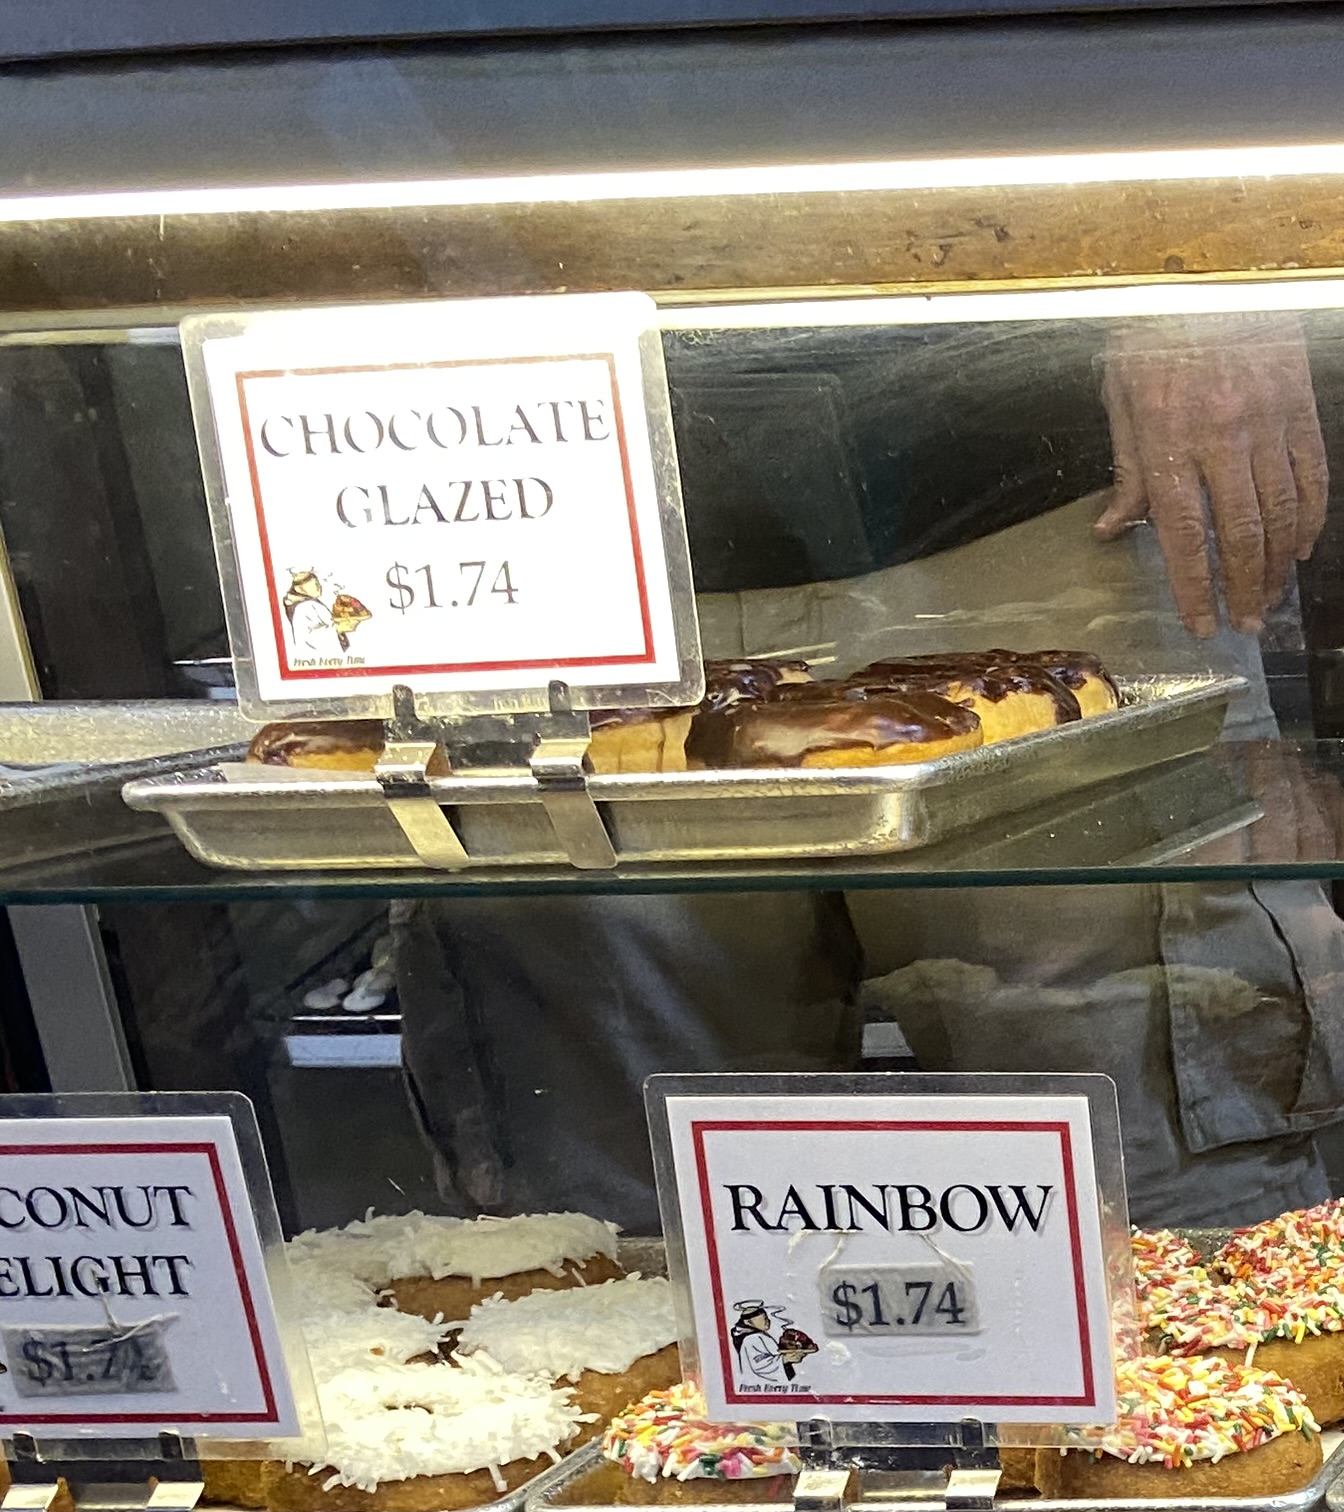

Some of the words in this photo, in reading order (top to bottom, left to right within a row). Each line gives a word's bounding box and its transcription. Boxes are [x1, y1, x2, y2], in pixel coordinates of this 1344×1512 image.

[259, 399, 611, 458] CHOCOLATE
[335, 476, 554, 529] GLAZED
[384, 560, 519, 616] $1.74
[723, 1184, 1054, 1233] RAINBOW
[833, 1280, 965, 1330] $1.74
